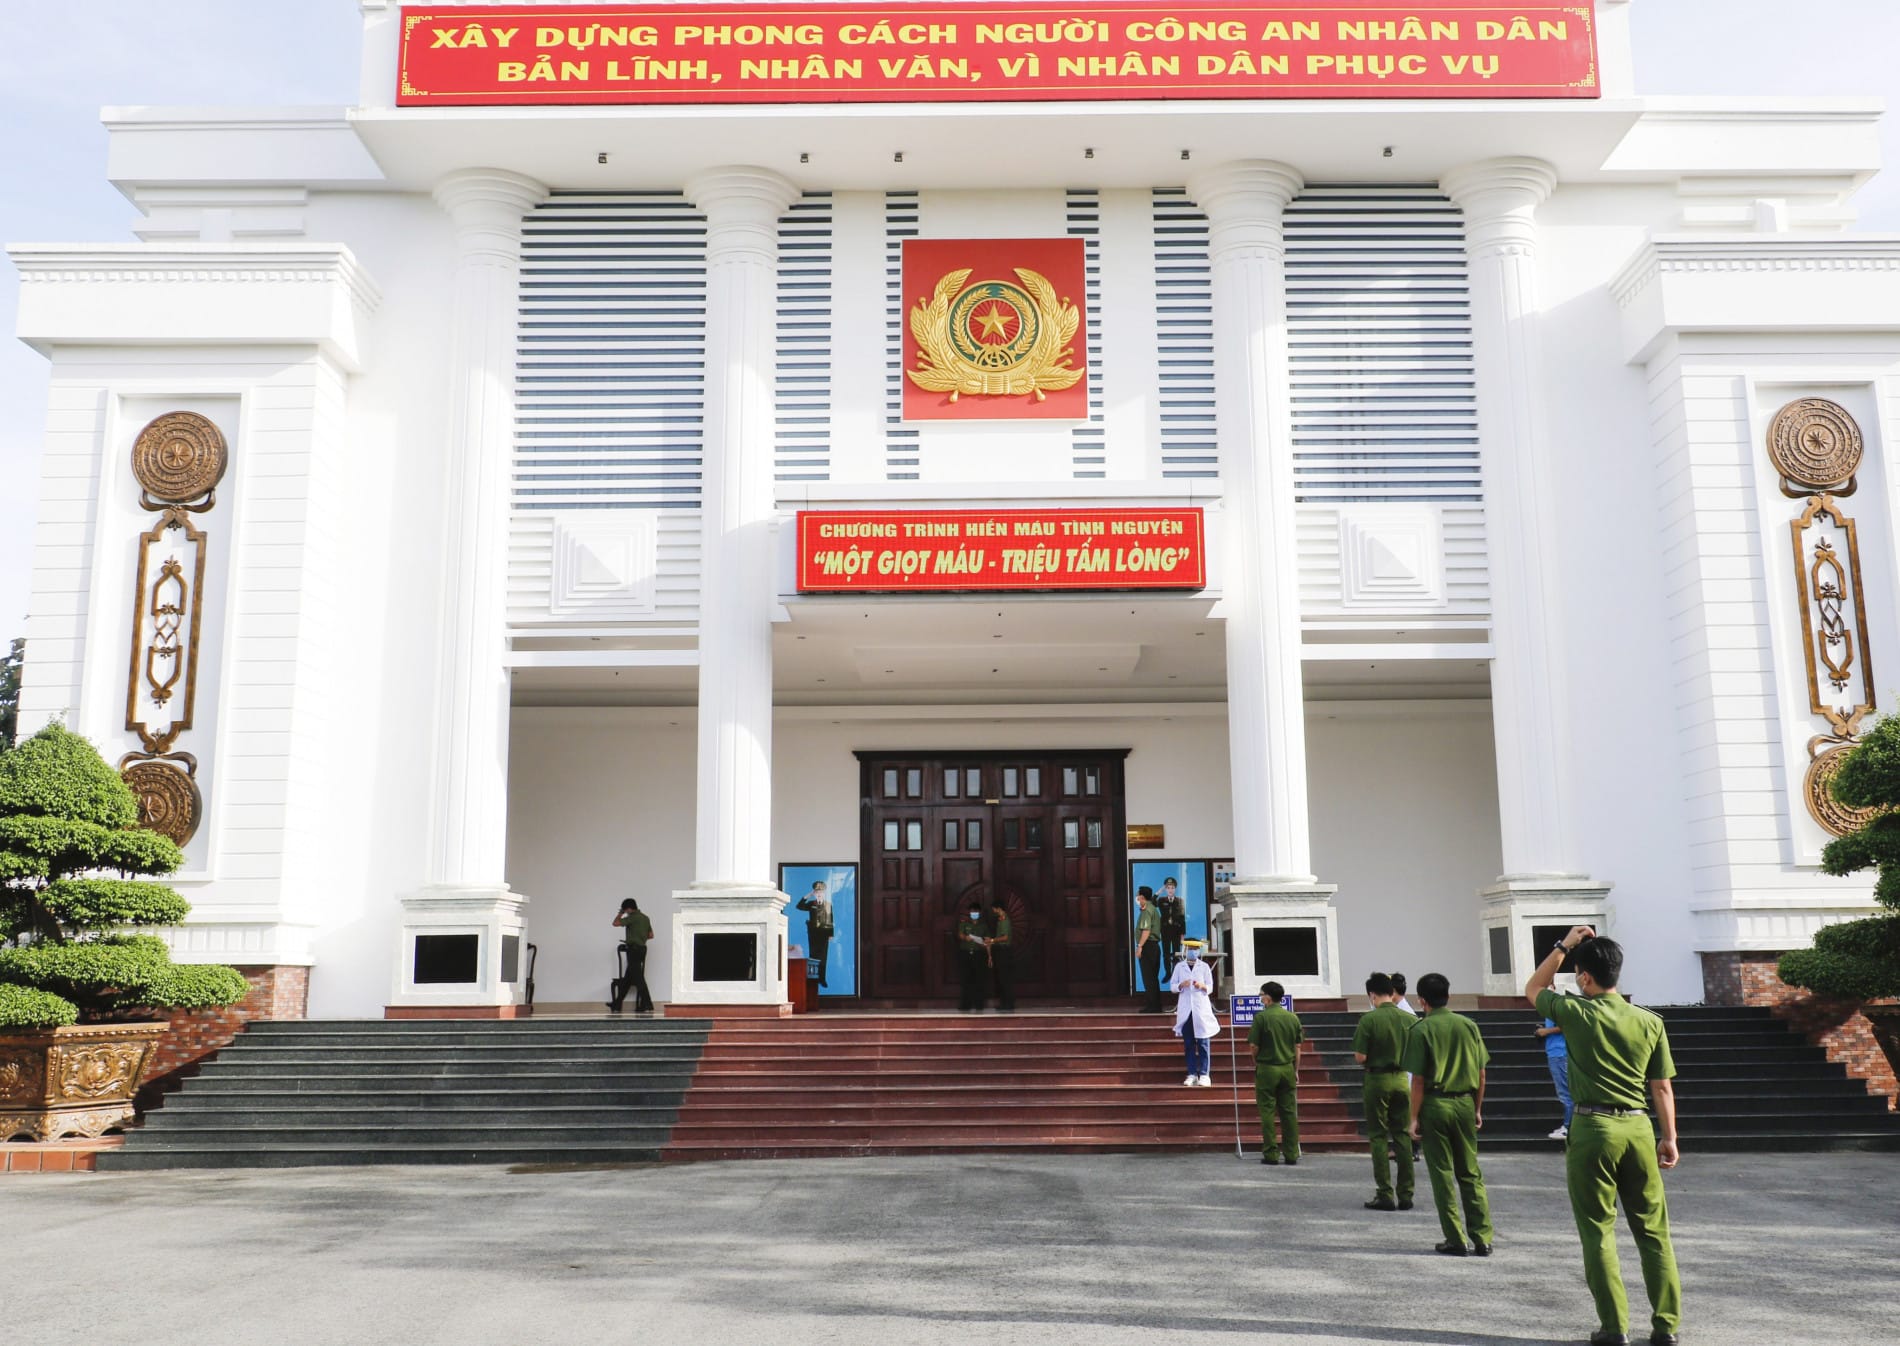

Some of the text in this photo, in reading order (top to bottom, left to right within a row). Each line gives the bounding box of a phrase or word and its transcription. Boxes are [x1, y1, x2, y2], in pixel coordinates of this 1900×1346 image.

[430, 15, 1568, 51] XÂY DỰNG PHONG CÁCH NGƯỜI CÔNG AN NHÂN DÂN
[497, 50, 1501, 84] BẢN LĨNH, NHÂN VĂN, VÌ NHÂN DÂN PHỤC VỤ
[820, 518, 1183, 537] CHƯƠNG TRÌNH HIẾN MÁU TÌNH NGUYỆN
[814, 544, 873, 582] “MỘT
[877, 550, 932, 582] GIỌT
[933, 542, 984, 574] MÁU
[1001, 543, 1061, 580] TRIỆU
[1066, 537, 1111, 572] TẤM
[1115, 540, 1190, 572] LÒNG”
